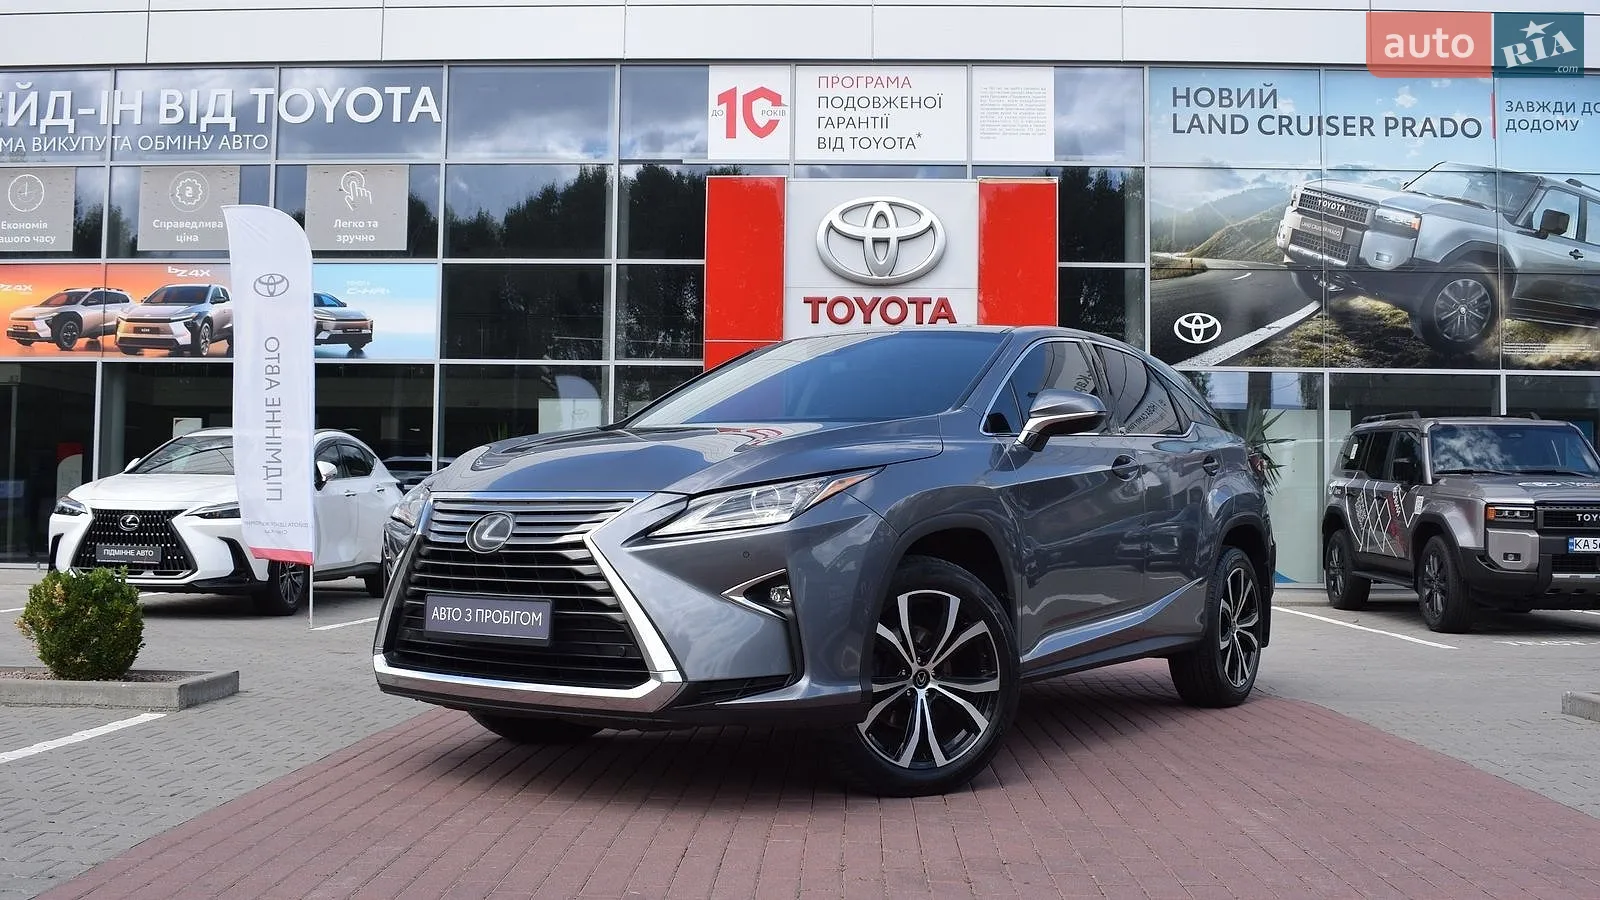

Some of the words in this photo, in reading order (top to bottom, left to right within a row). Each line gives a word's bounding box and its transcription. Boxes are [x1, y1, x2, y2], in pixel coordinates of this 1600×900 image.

[818, 76, 912, 89] ПРОГРАМА
[818, 93, 944, 112] ПОДОВЖЕНОЇ
[1172, 82, 1278, 109] НОВИЙ
[0, 81, 143, 135] ЙД-ІН
[159, 88, 237, 133] ВІД
[249, 86, 442, 124] TOYOTA
[711, 109, 724, 118] ДО
[717, 86, 783, 139] 10
[761, 109, 786, 117] РОКІВ
[1505, 100, 1576, 116] ЗАВЖДИ
[818, 113, 890, 129] ГАРАНТІЇ
[1172, 113, 1249, 135] LAND
[1257, 114, 1375, 137] CRUISER
[1384, 116, 1483, 139] PRADO
[1505, 118, 1580, 133] ДОДОМУ
[32, 136, 107, 152] ВИКУПУ
[113, 135, 132, 151] ТА
[138, 134, 215, 151] ОБМІНУ
[219, 134, 269, 150] АВТО
[817, 136, 845, 152] ВІД
[1318, 199, 1346, 213] TOYOTA
[1, 219, 48, 230] Економія
[152, 219, 224, 231] Справедлива
[333, 218, 365, 229] Легко
[366, 220, 379, 228] та
[32, 236, 56, 245] часу
[176, 232, 199, 243] ціна
[336, 234, 376, 244] зручно
[803, 296, 958, 325] TOYOTA
[1576, 513, 1600, 521] TOY
[1592, 539, 1600, 550] 5
[103, 549, 135, 557] ПІДМІННЕ
[431, 606, 462, 622] АВТО
[464, 608, 472, 622] З
[475, 608, 543, 626] ПРОБІГОМ
